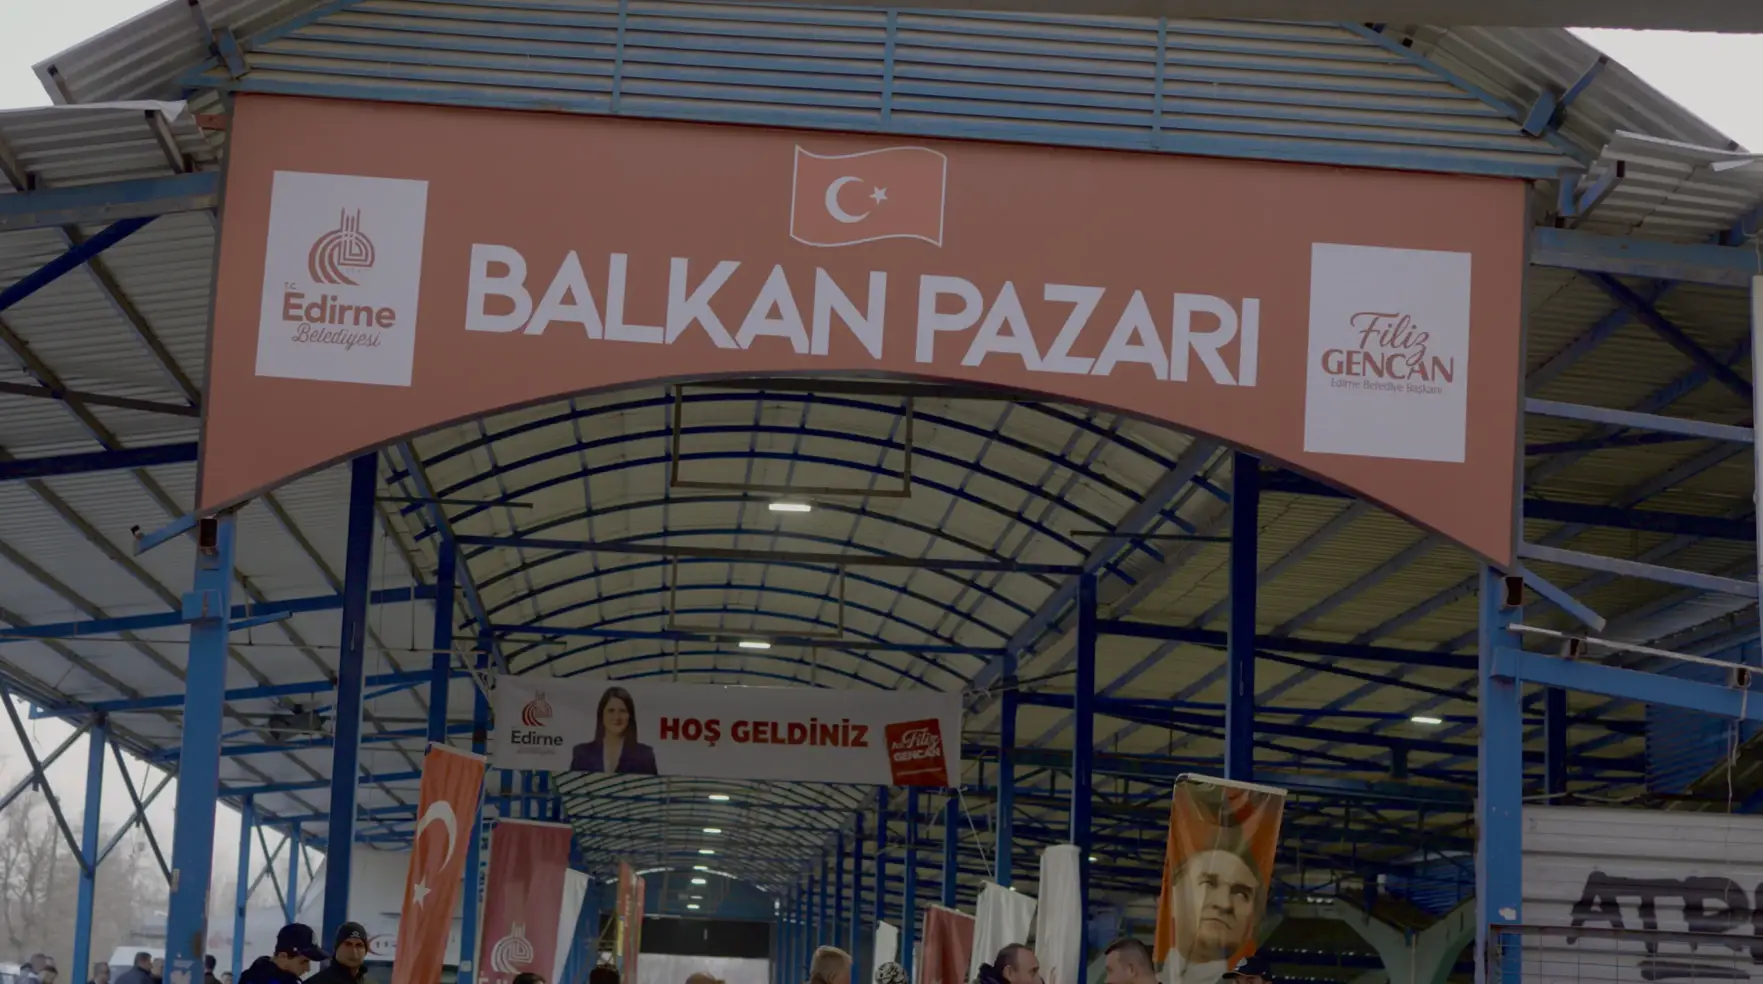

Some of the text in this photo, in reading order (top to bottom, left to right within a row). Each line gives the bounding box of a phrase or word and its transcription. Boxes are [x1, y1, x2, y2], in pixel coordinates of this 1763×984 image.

[282, 291, 396, 329] Edirne
[465, 243, 1260, 387] BALKAN PAZARI
[291, 322, 381, 351] Belediyesi
[1350, 312, 1429, 366] Filiz
[1321, 349, 1454, 383] GENCAN
[511, 729, 563, 746] Edirne
[660, 717, 869, 748] HOŞ GELDİNİZ
